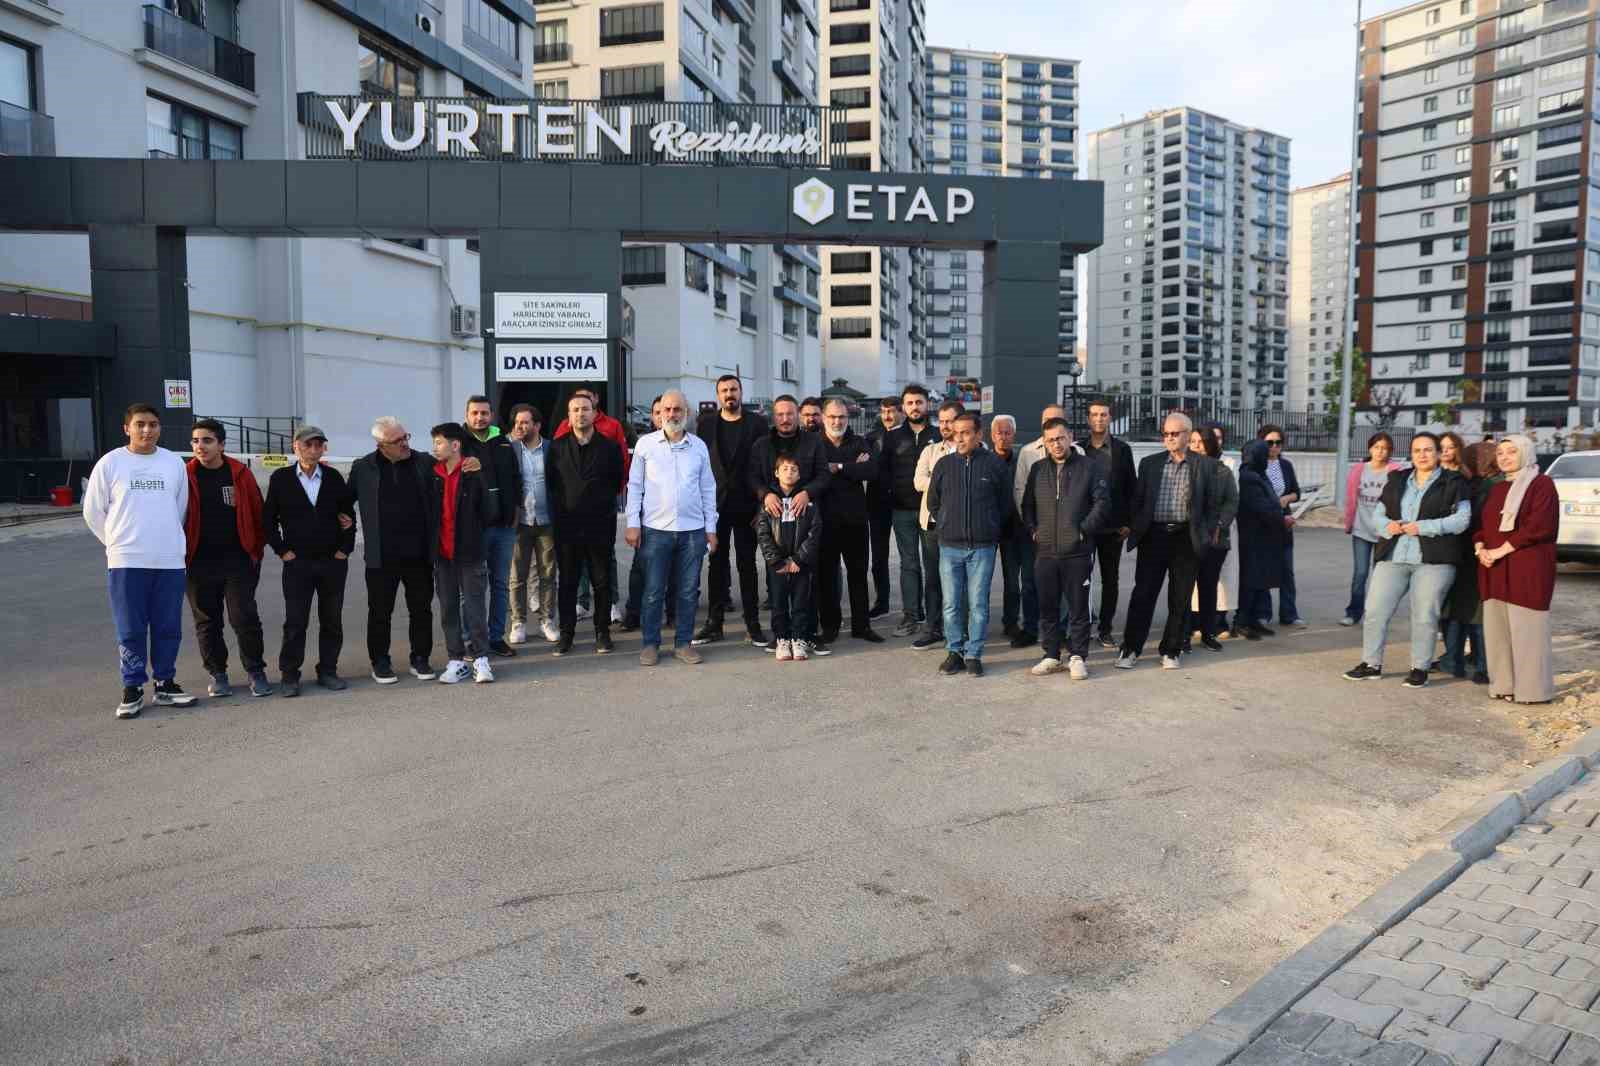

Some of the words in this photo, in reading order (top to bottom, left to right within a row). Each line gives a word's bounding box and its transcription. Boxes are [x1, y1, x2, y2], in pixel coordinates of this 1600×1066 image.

[324, 101, 632, 155] YURTEN
[649, 120, 823, 157] Rezidans
[847, 184, 975, 223] ETAP
[501, 320, 538, 329] ARAÇLAR
[503, 356, 597, 373] DANIŞMA
